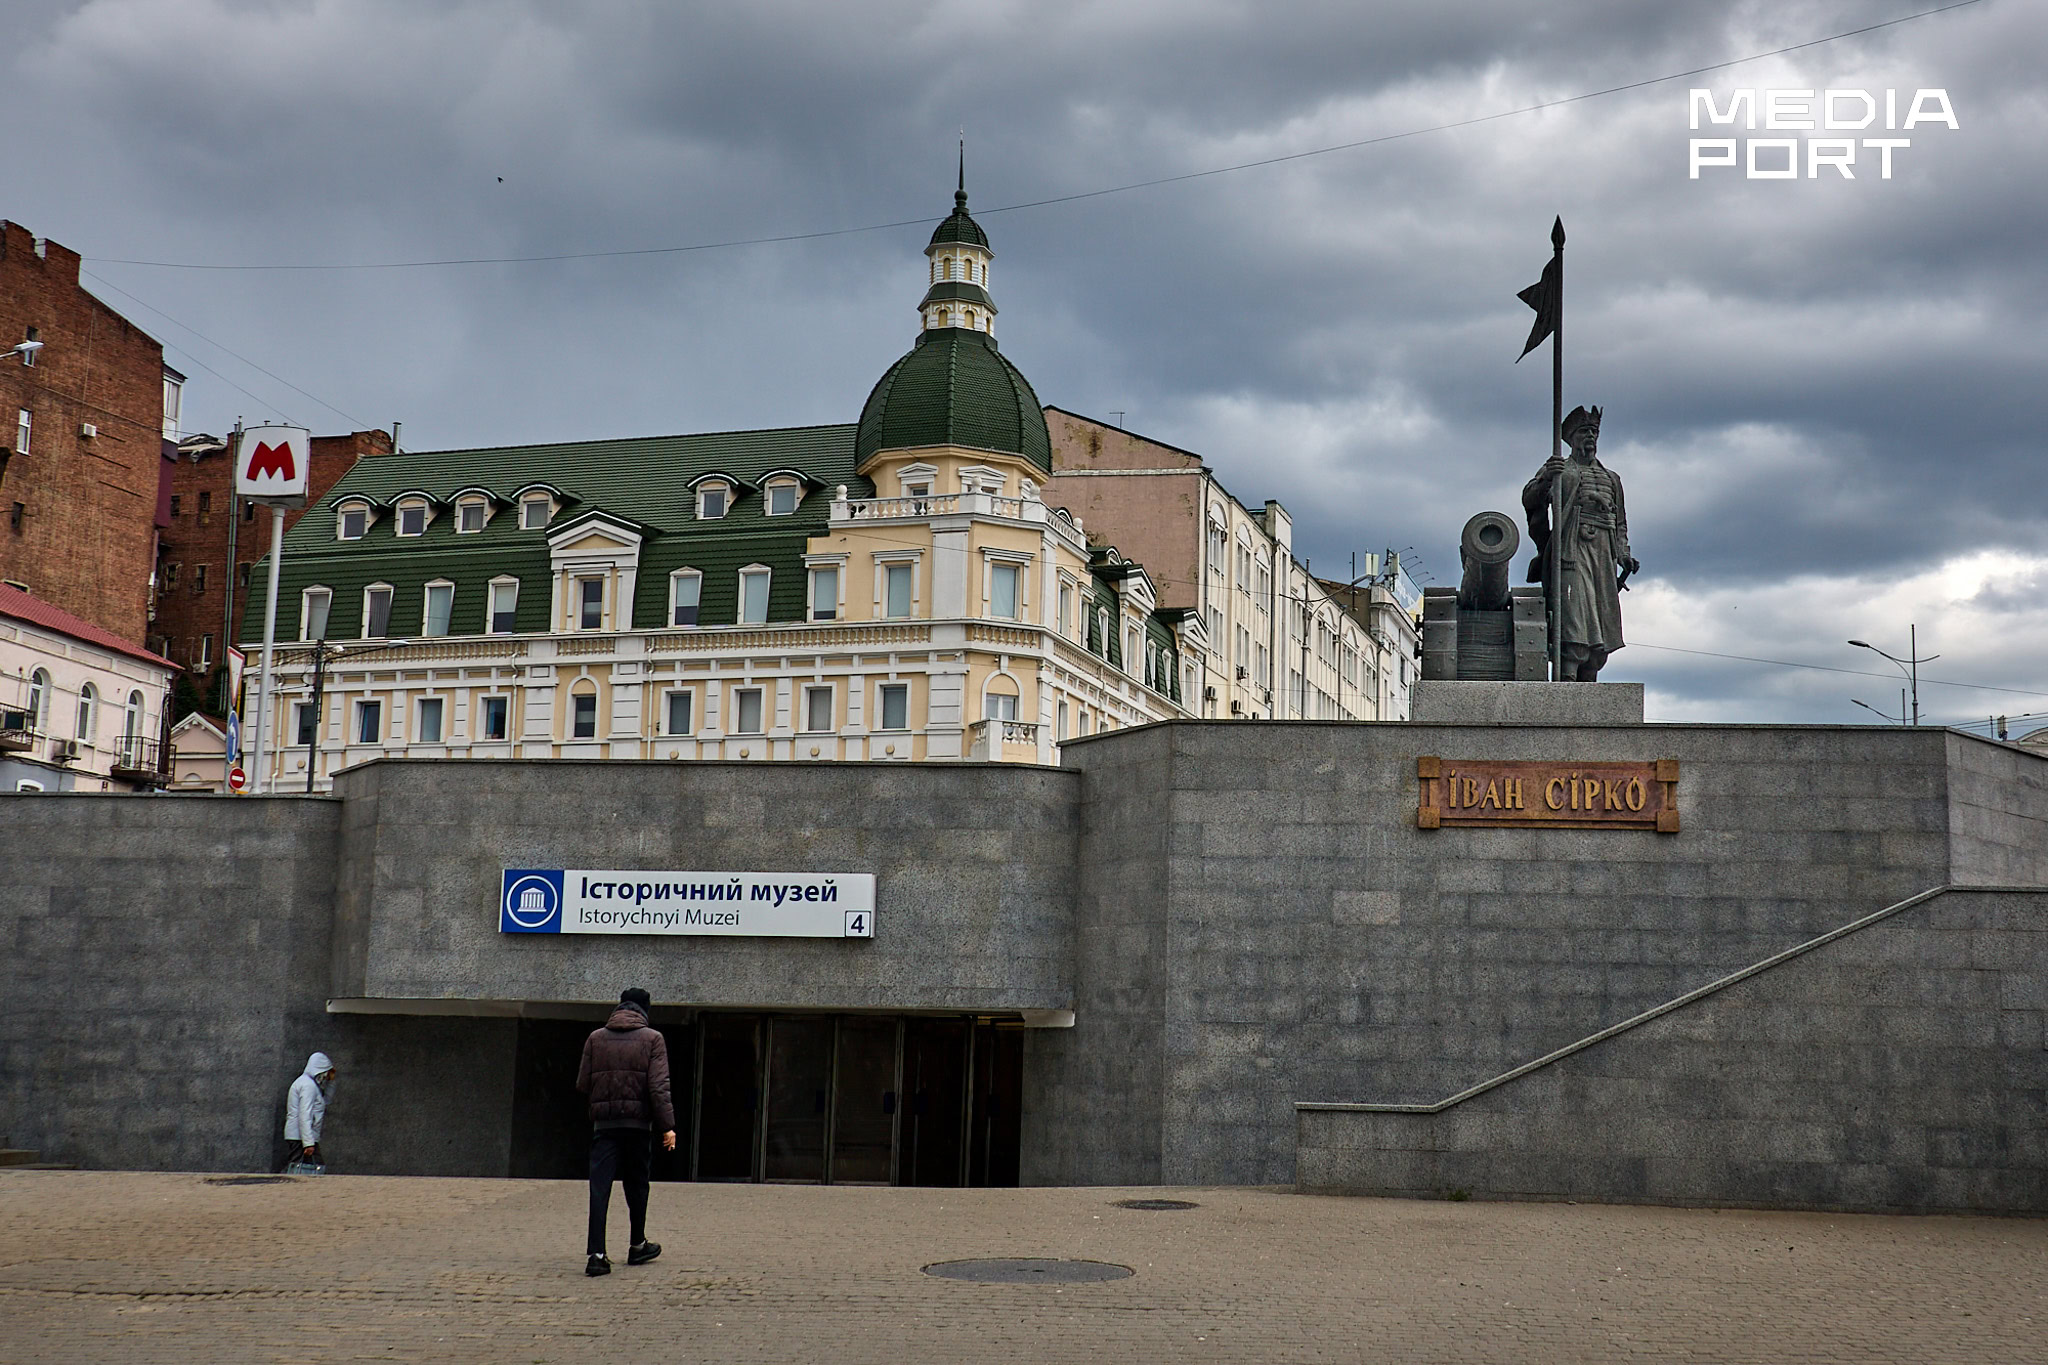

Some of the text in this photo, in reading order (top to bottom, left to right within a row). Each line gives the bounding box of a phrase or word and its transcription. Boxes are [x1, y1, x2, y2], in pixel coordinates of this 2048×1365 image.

[1447, 768, 1525, 810] ІВАН
[580, 876, 838, 908] Історичний музей
[579, 907, 740, 930] Istorychnyi Muzei
[850, 914, 865, 934] 4
